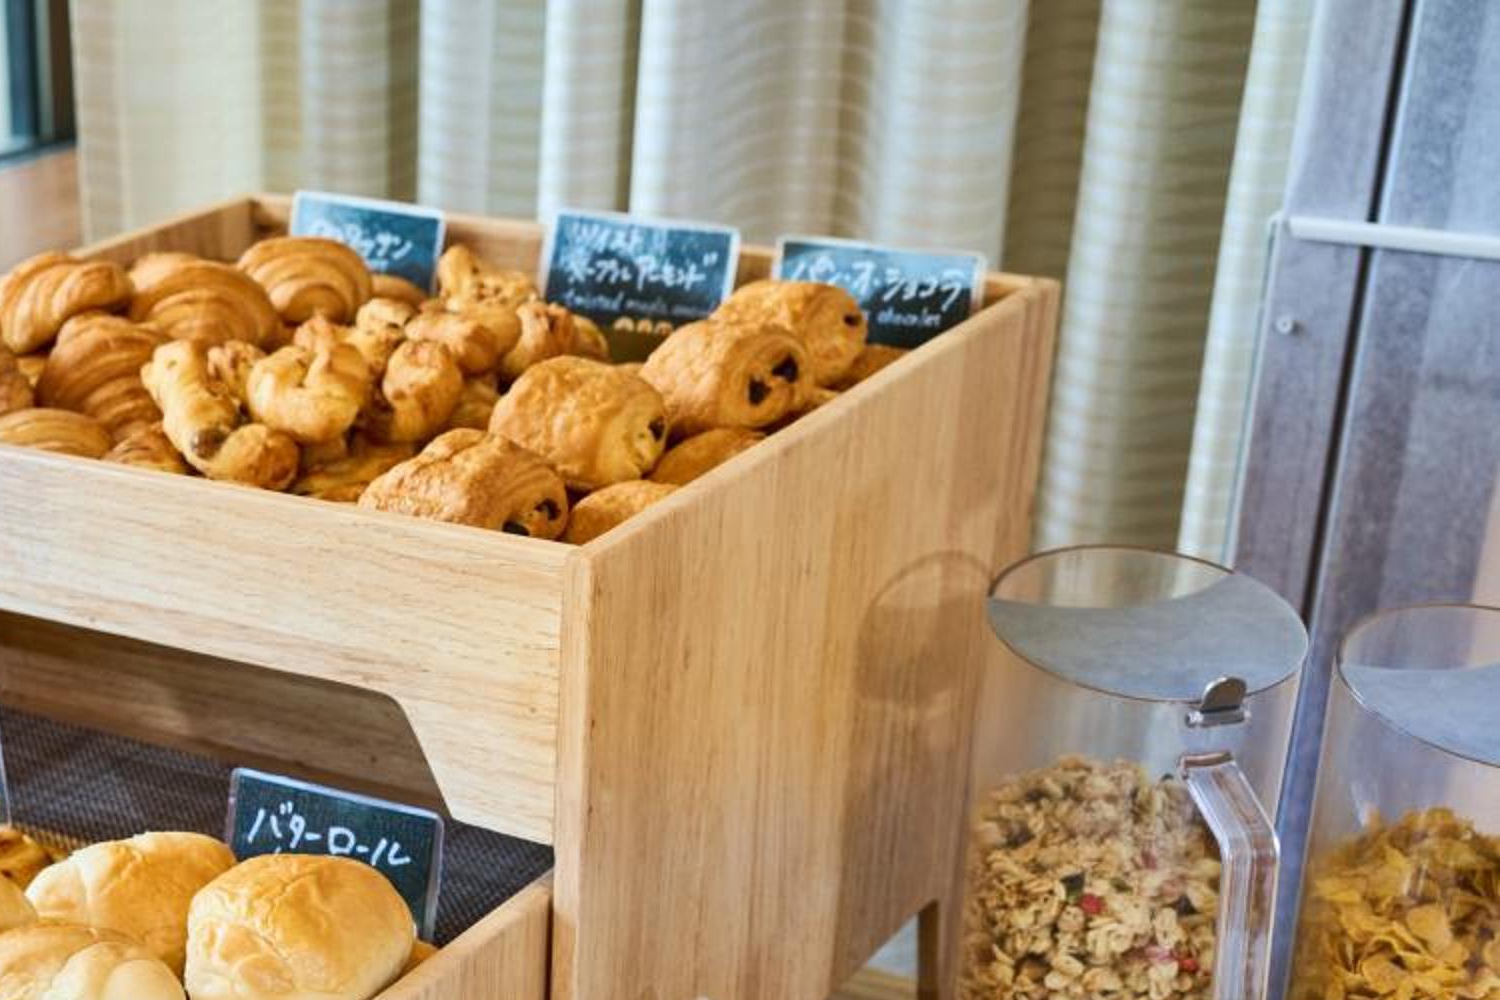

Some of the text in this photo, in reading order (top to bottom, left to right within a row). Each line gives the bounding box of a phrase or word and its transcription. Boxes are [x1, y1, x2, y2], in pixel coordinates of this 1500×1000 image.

[247, 801, 412, 867] バターロール
